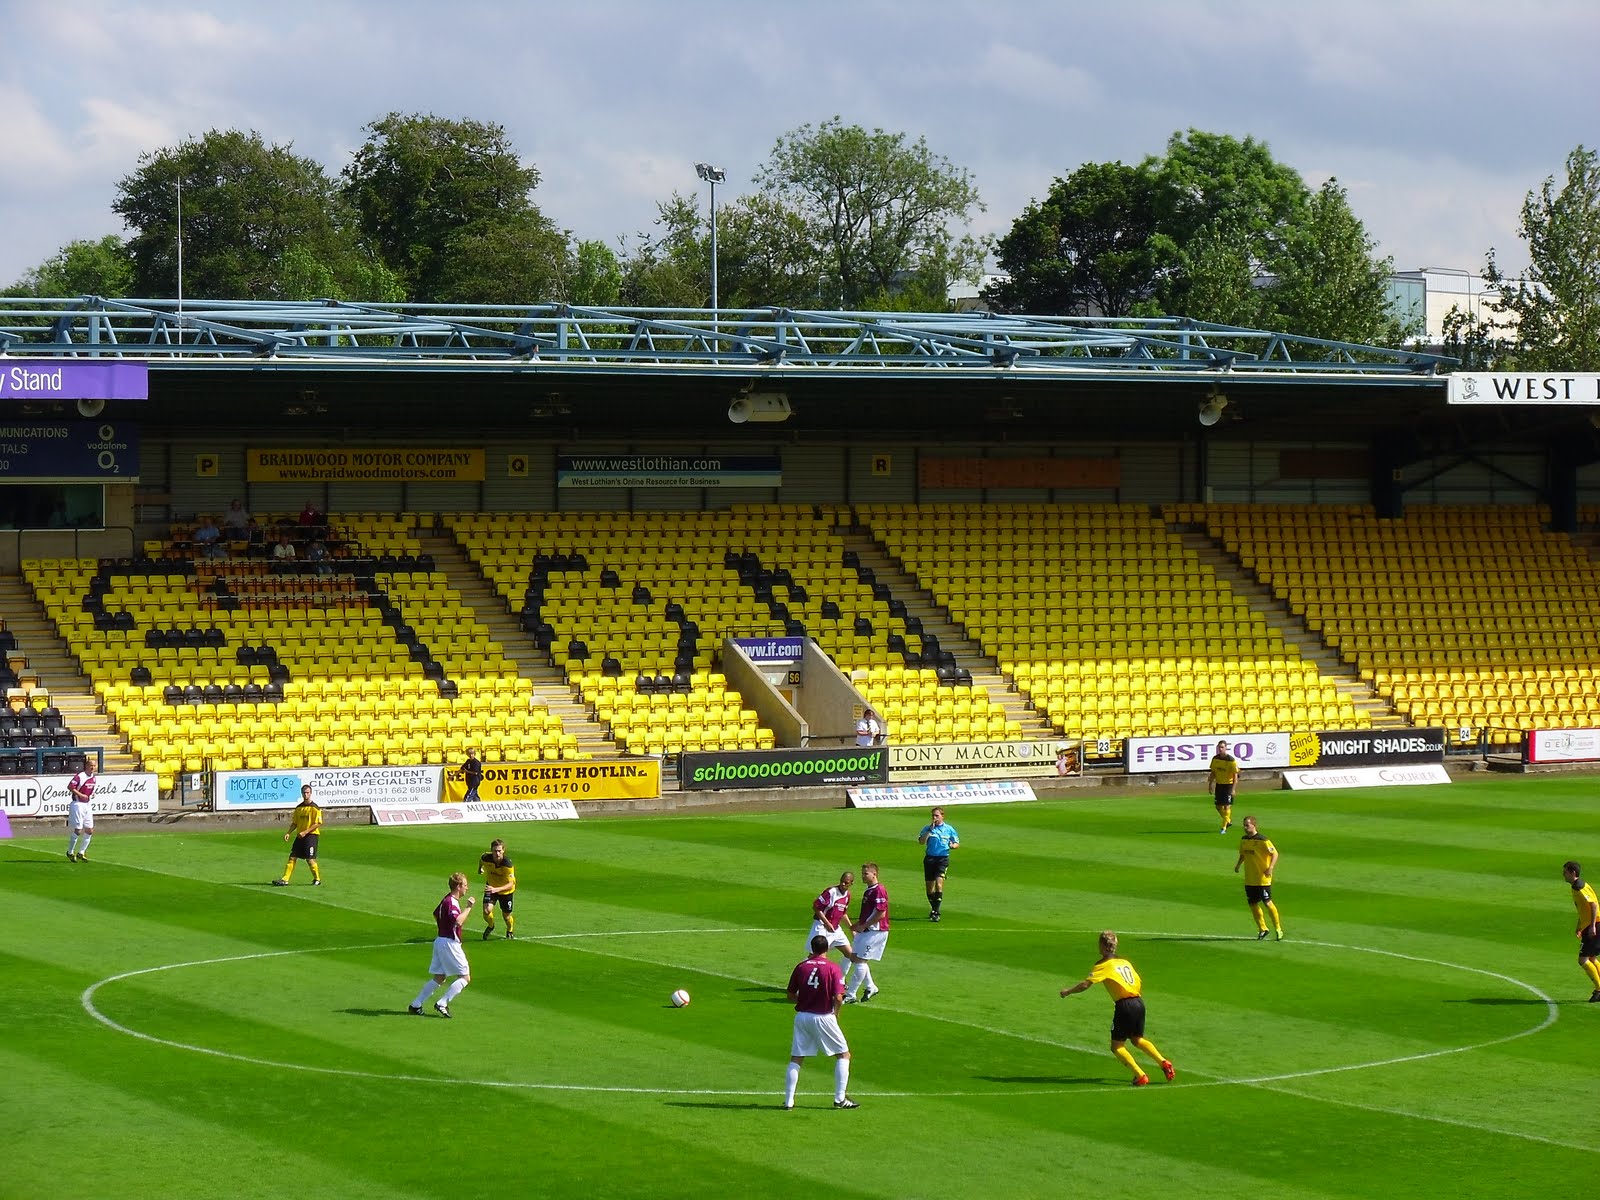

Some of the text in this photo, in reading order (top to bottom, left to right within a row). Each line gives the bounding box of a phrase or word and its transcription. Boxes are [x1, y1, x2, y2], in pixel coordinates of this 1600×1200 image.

[10, 367, 62, 391] Stand
[1492, 378, 1575, 400] WEST
[87, 442, 127, 450] vodafone
[201, 459, 213, 472] P
[259, 452, 472, 466] BRAIDWOOD MOTOR COMPANY
[571, 457, 721, 472] www.westlothian.com
[875, 459, 887, 472] R
[511, 459, 524, 473] Q
[279, 467, 456, 480] www.braidwoodmotors.com
[571, 476, 721, 486] West Lothian's Online Resource for Business
[742, 642, 802, 657] ww.if.com
[789, 672, 800, 683] S6
[1461, 730, 1470, 740] 24
[1098, 742, 1109, 752] 23
[1289, 733, 1313, 751] Blind
[1322, 739, 1371, 756] KNIGHT
[893, 747, 943, 762] TONY
[1294, 747, 1314, 763] Sale
[314, 770, 427, 780] MOTOR ACCIDENT
[447, 769, 509, 782] SEON
[512, 767, 572, 780] TICKET
[823, 775, 866, 783] www.schuh.co.uk
[1299, 769, 1438, 786] COURIER COURIER
[122, 779, 147, 793] Ltd
[231, 778, 268, 791] MOFFAT
[271, 777, 279, 789] &
[309, 777, 433, 788] CLAIM SPECIALISTS
[314, 789, 359, 797] Telephone
[367, 787, 388, 795] 0131
[410, 786, 431, 794] 6988
[495, 785, 538, 796] 01506
[327, 796, 420, 805] www.moffatandco.co.uk
[858, 794, 899, 802] LEARN
[116, 802, 149, 811] 882335
[467, 801, 569, 813] MULHOLLAND PLANT
[486, 812, 559, 822] SERVICES LTD
[807, 967, 820, 989] 4
[1116, 965, 1134, 985] 10
